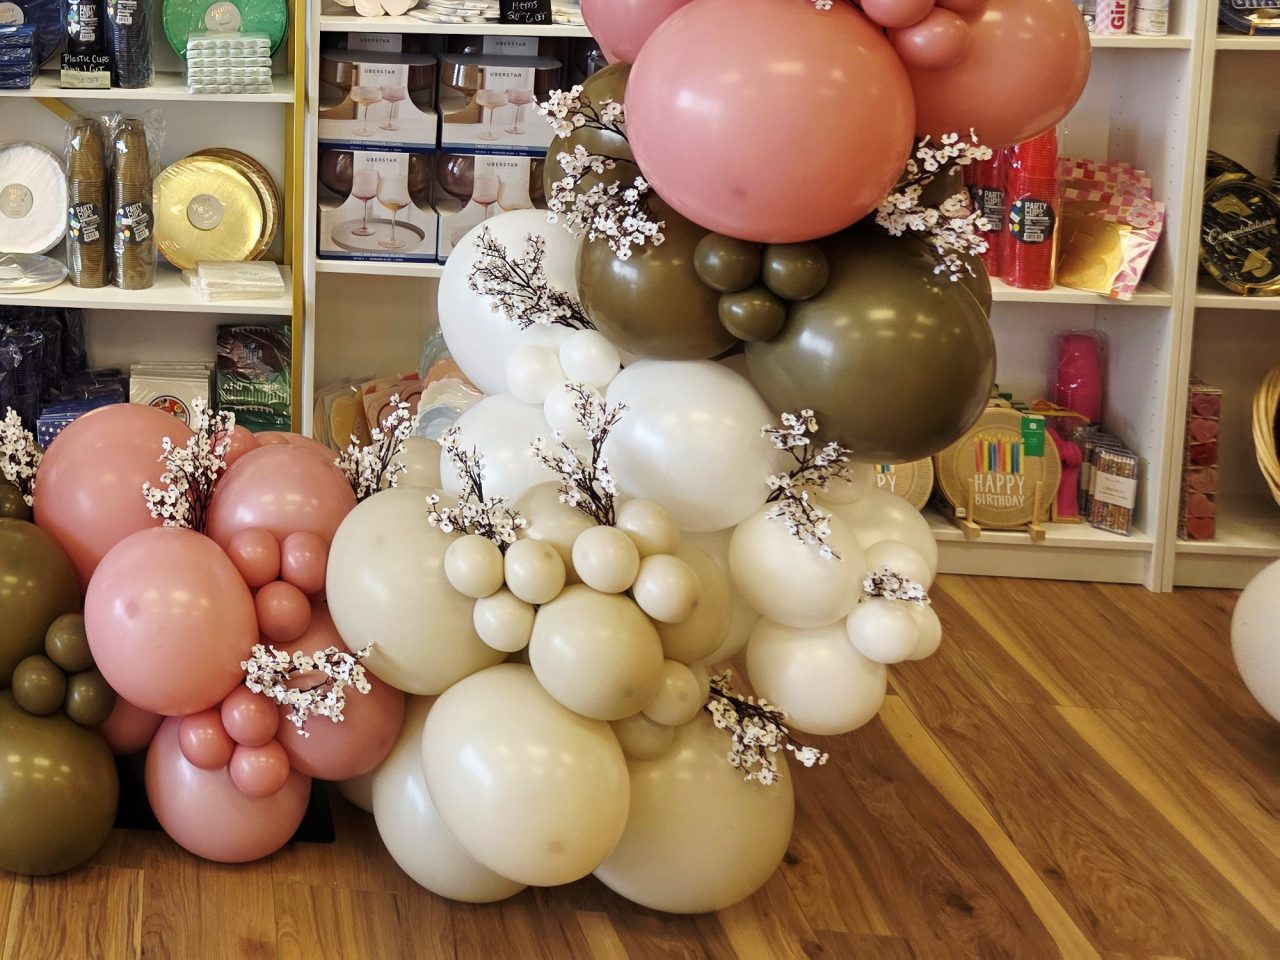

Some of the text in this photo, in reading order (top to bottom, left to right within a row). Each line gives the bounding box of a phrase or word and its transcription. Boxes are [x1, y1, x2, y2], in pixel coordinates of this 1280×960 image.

[985, 191, 1005, 199] PARTY
[76, 203, 93, 213] PARTY
[126, 202, 142, 214] PARTY
[1025, 202, 1047, 210] PARTY
[974, 473, 1025, 495] HAPPY
[975, 493, 1025, 507] BIRTHDAY
